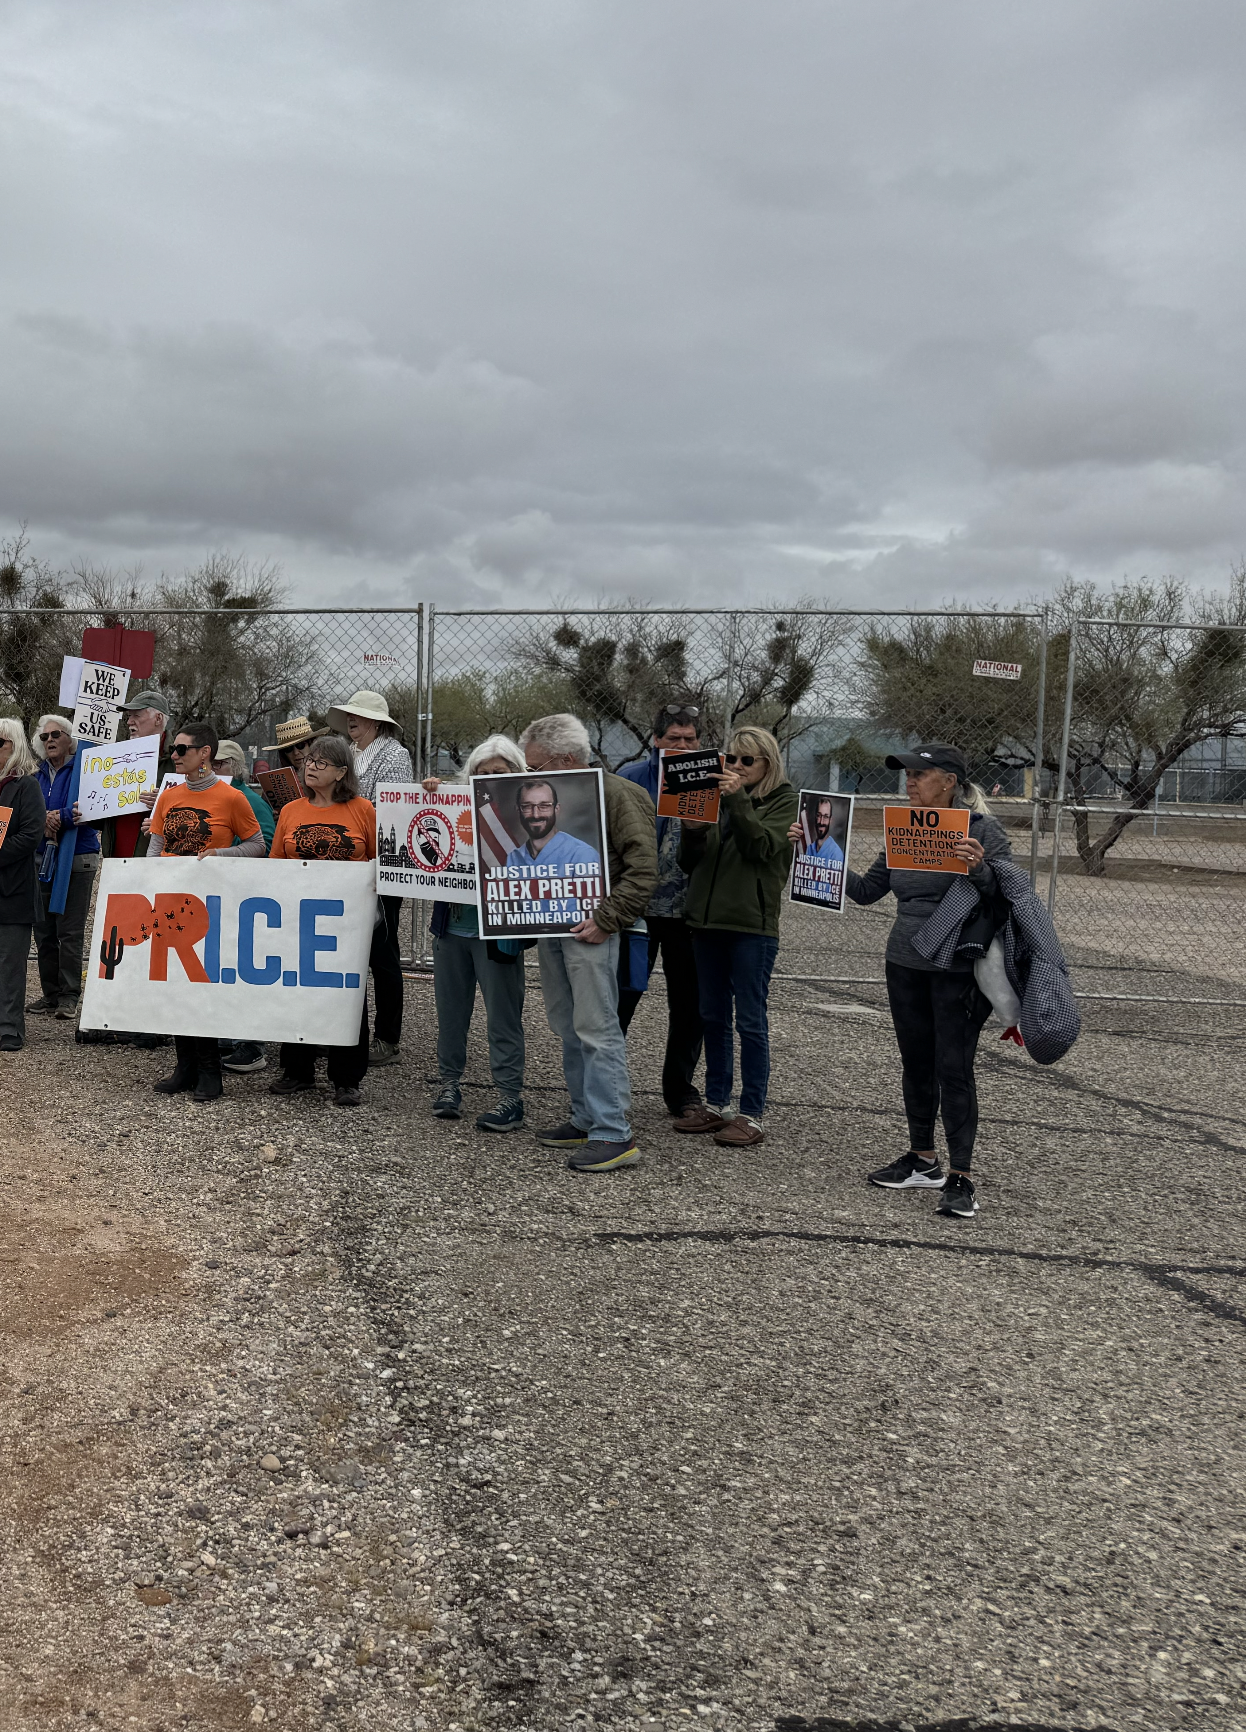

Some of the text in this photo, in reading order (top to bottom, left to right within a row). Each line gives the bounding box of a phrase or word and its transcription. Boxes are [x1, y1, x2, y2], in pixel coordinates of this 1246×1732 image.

[975, 661, 1019, 673] NATIONAL
[94, 669, 115, 686] WE
[83, 680, 120, 699] KEEP
[78, 722, 112, 740] SAFE
[668, 758, 718, 772] ABOLISH
[102, 768, 147, 788] estás
[118, 784, 155, 808] sol
[380, 791, 472, 806] STOP THE KIDNAPPIN
[910, 810, 940, 828] NO
[888, 827, 964, 840] KIDNAPPINGS
[892, 848, 955, 858] CONCENTRATIO
[485, 862, 600, 880] JUSTICE FOR
[796, 854, 843, 871] JUSTICE FOR
[380, 871, 413, 884] PROTECT
[415, 874, 436, 886] YOUR
[795, 863, 842, 885] ALEX PRETTI
[486, 877, 601, 901] ALEX PRETTI
[793, 886, 840, 903] IN MINNEAPOLIS
[794, 878, 841, 895] KILLED BY ICE
[487, 898, 601, 914] KILLED BY ICE
[488, 911, 593, 926] IN MINNEAPOLI
